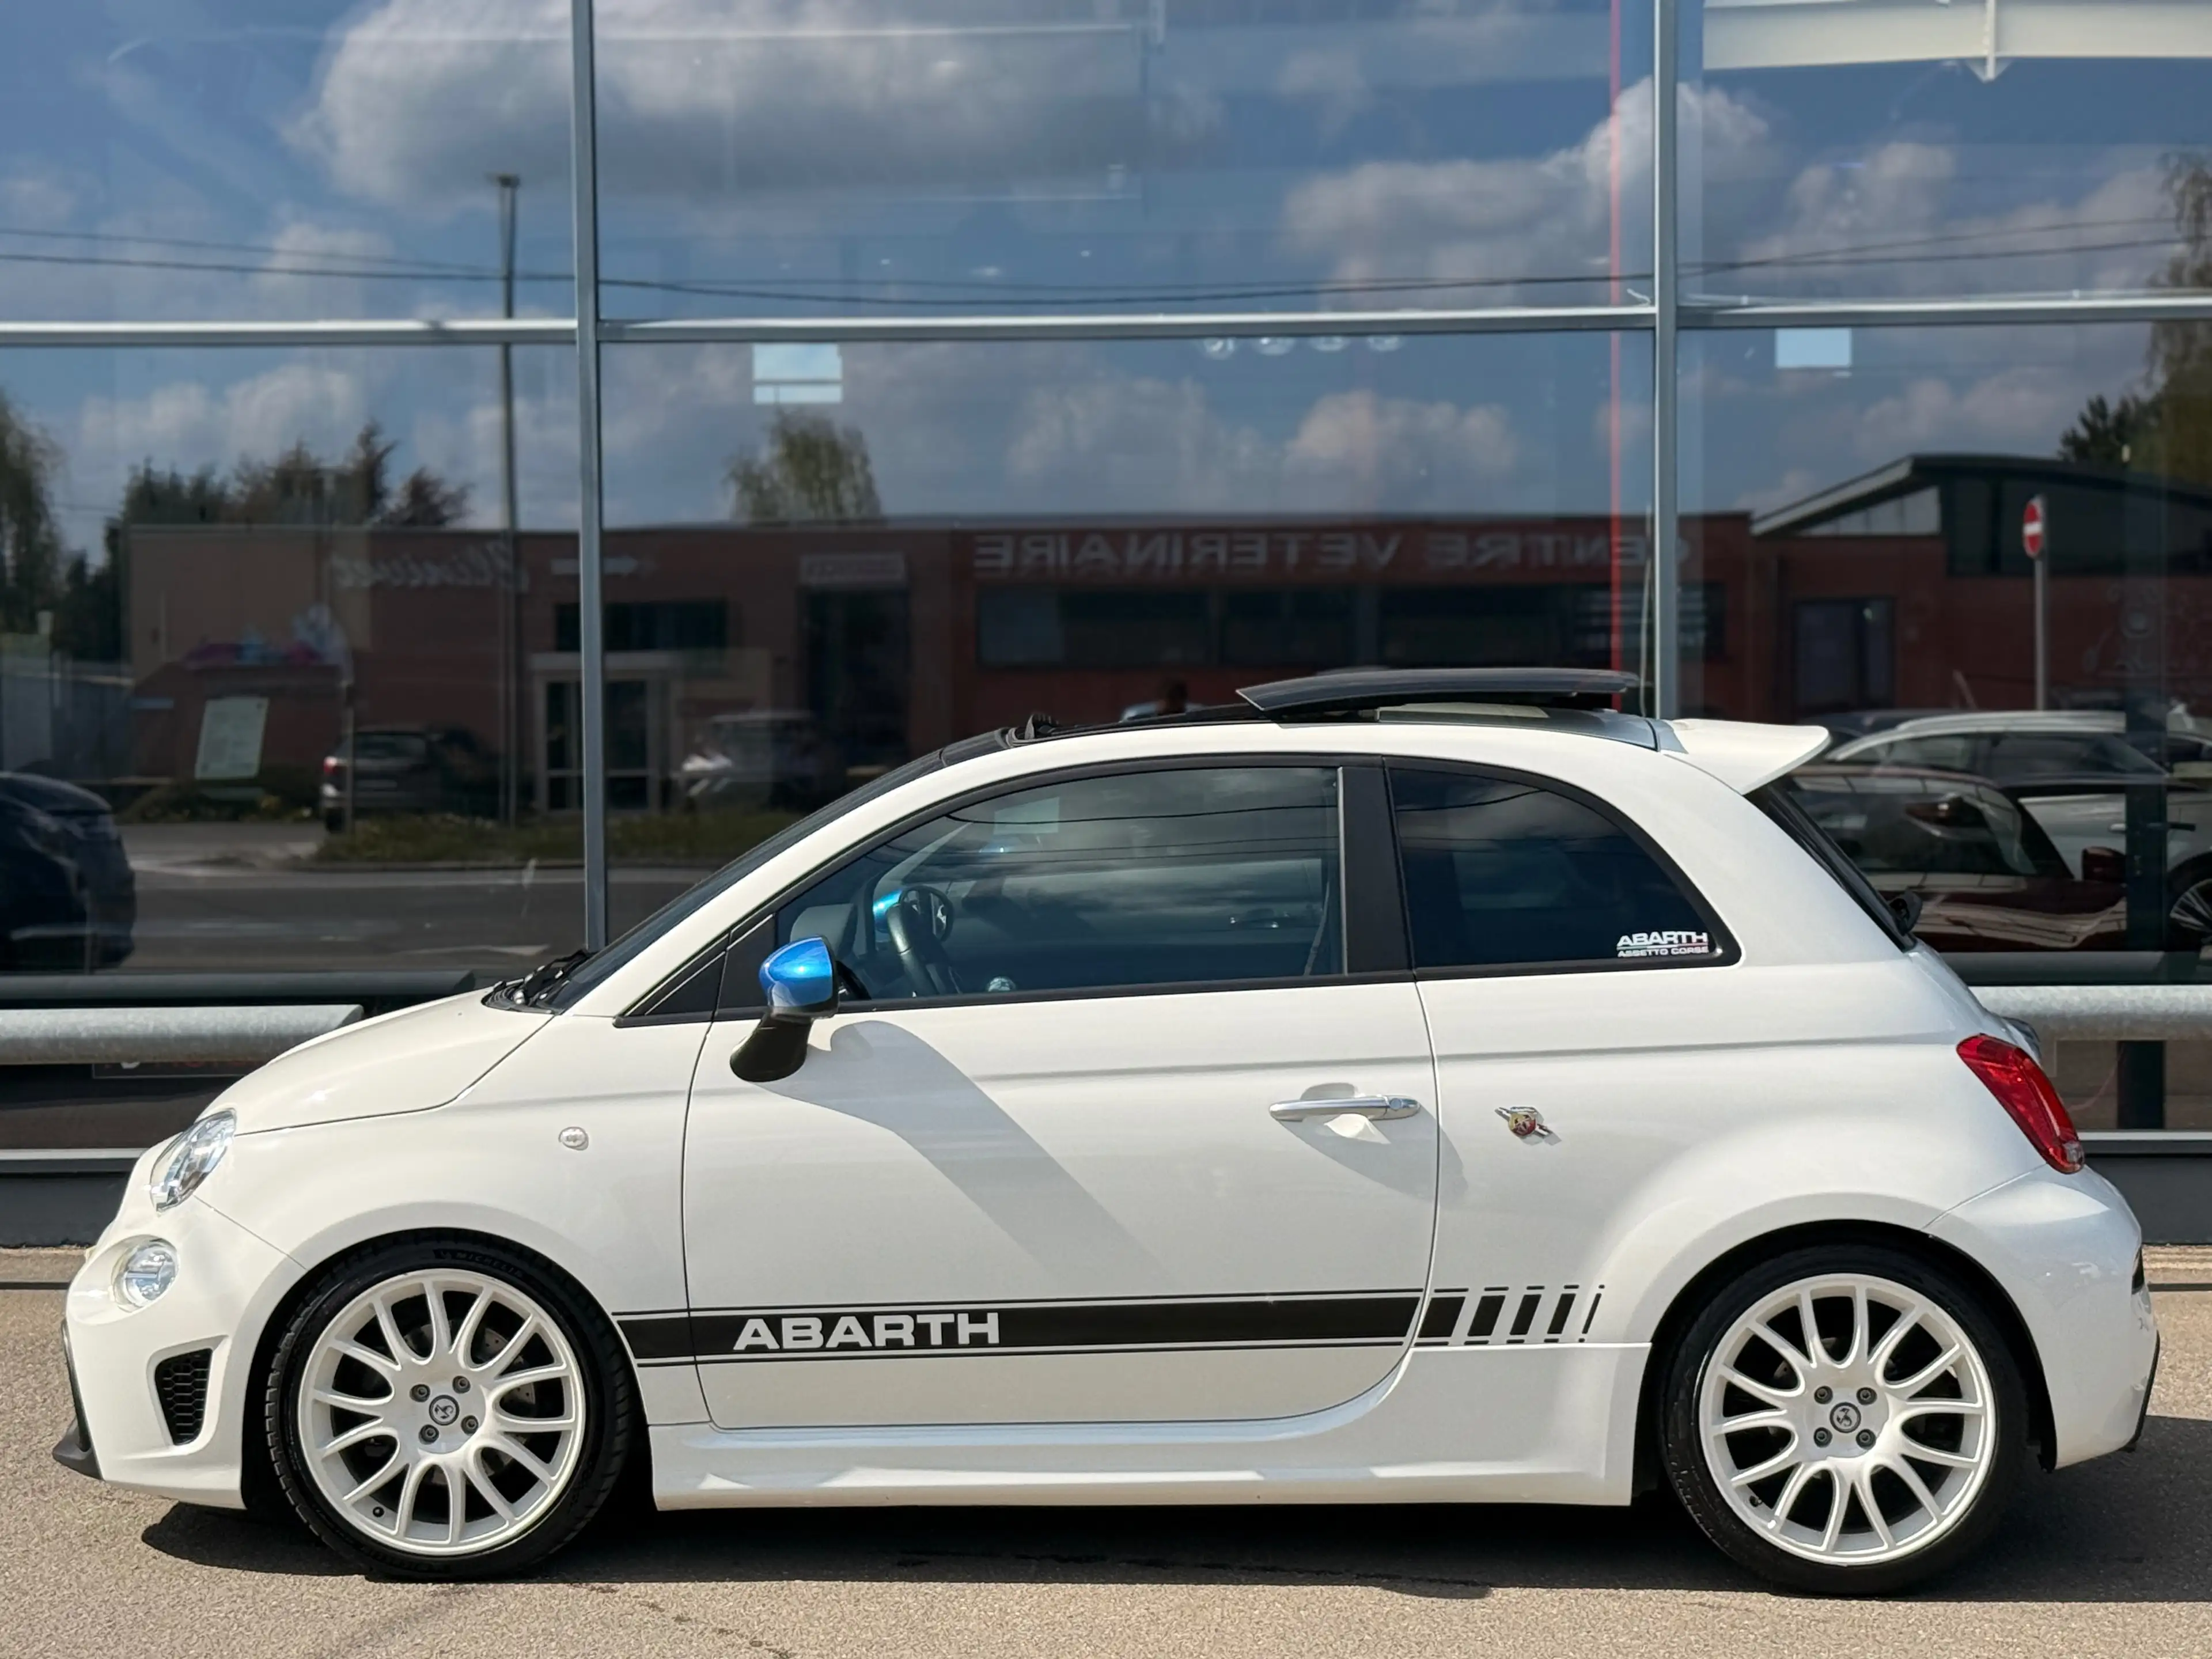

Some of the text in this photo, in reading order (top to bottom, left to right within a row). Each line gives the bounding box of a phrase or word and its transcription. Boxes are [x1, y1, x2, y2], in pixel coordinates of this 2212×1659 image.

[1616, 931, 1707, 946] ABARTH
[1618, 946, 1709, 957] ASSETTO CORSE
[733, 1312, 999, 1351] ABARTH
